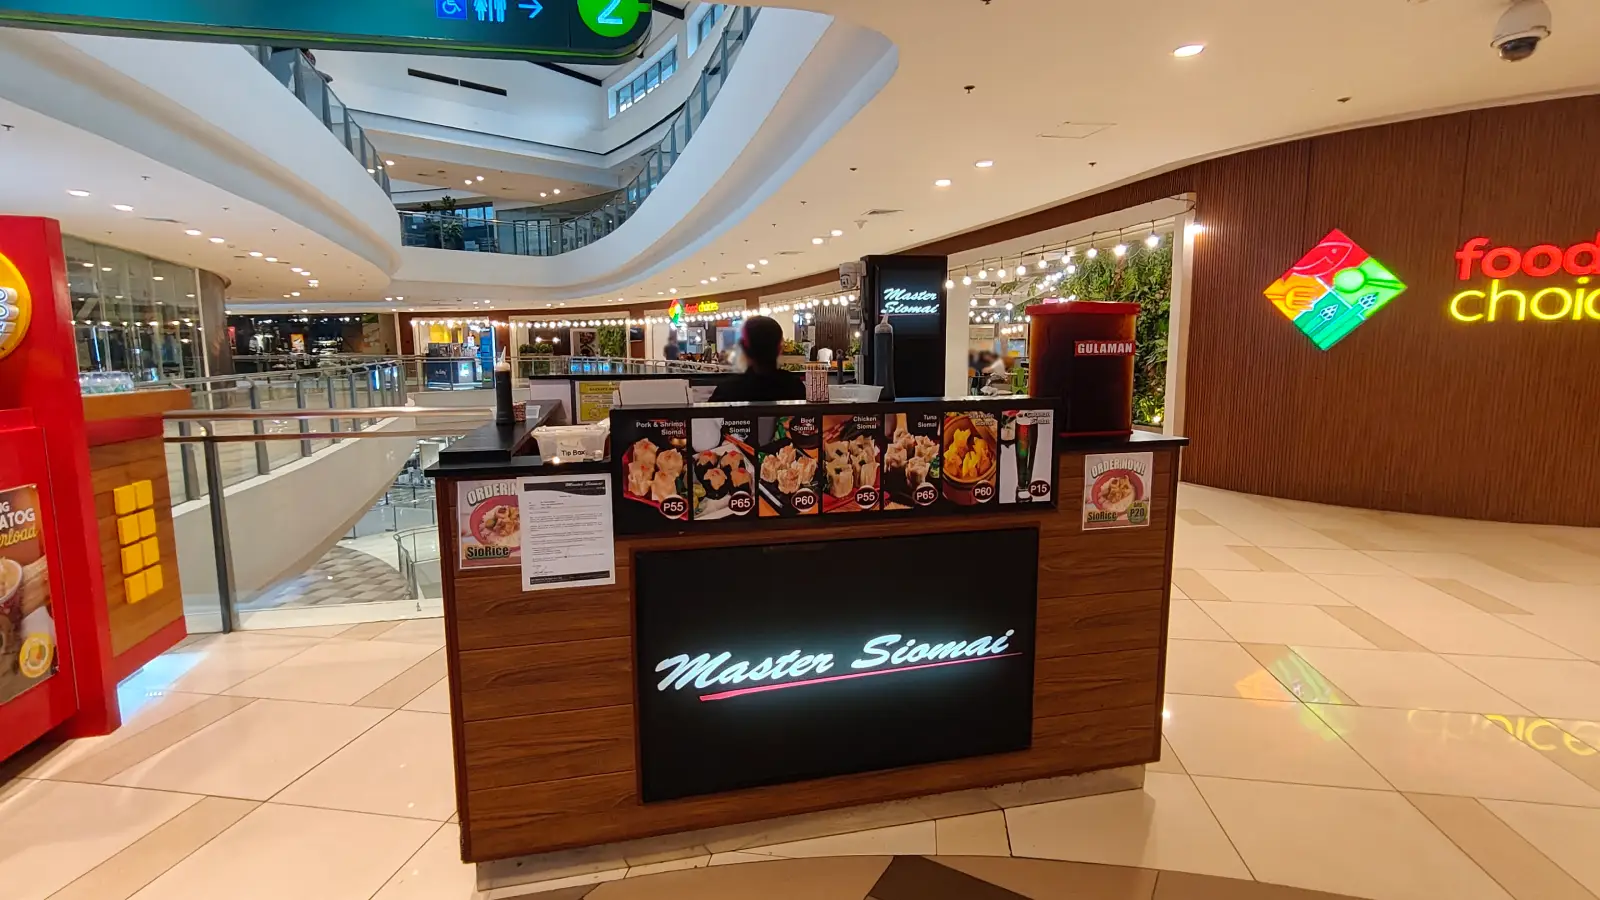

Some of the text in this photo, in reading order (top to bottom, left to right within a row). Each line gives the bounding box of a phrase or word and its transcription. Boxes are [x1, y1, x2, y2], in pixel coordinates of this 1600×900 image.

[597, 0, 624, 25] 2
[1455, 230, 1600, 281] food
[883, 287, 937, 301] Master
[880, 301, 940, 314] Siomai
[1078, 343, 1133, 354] GULAMAN
[660, 420, 683, 429] Shrimp
[721, 419, 751, 427] Japanese
[1091, 458, 1147, 478] ORDER NOW!
[974, 487, 992, 497] P60
[1030, 483, 1048, 493] P15
[467, 483, 509, 506] ORDER
[856, 492, 875, 501] P55
[916, 490, 935, 500] P65
[731, 498, 750, 508] P65
[795, 496, 814, 505] P60
[663, 501, 684, 512] P55
[1087, 510, 1117, 521] SioRice
[1130, 508, 1145, 517] P20
[467, 546, 509, 558] SioRice
[655, 628, 1015, 692] Master Siomai
